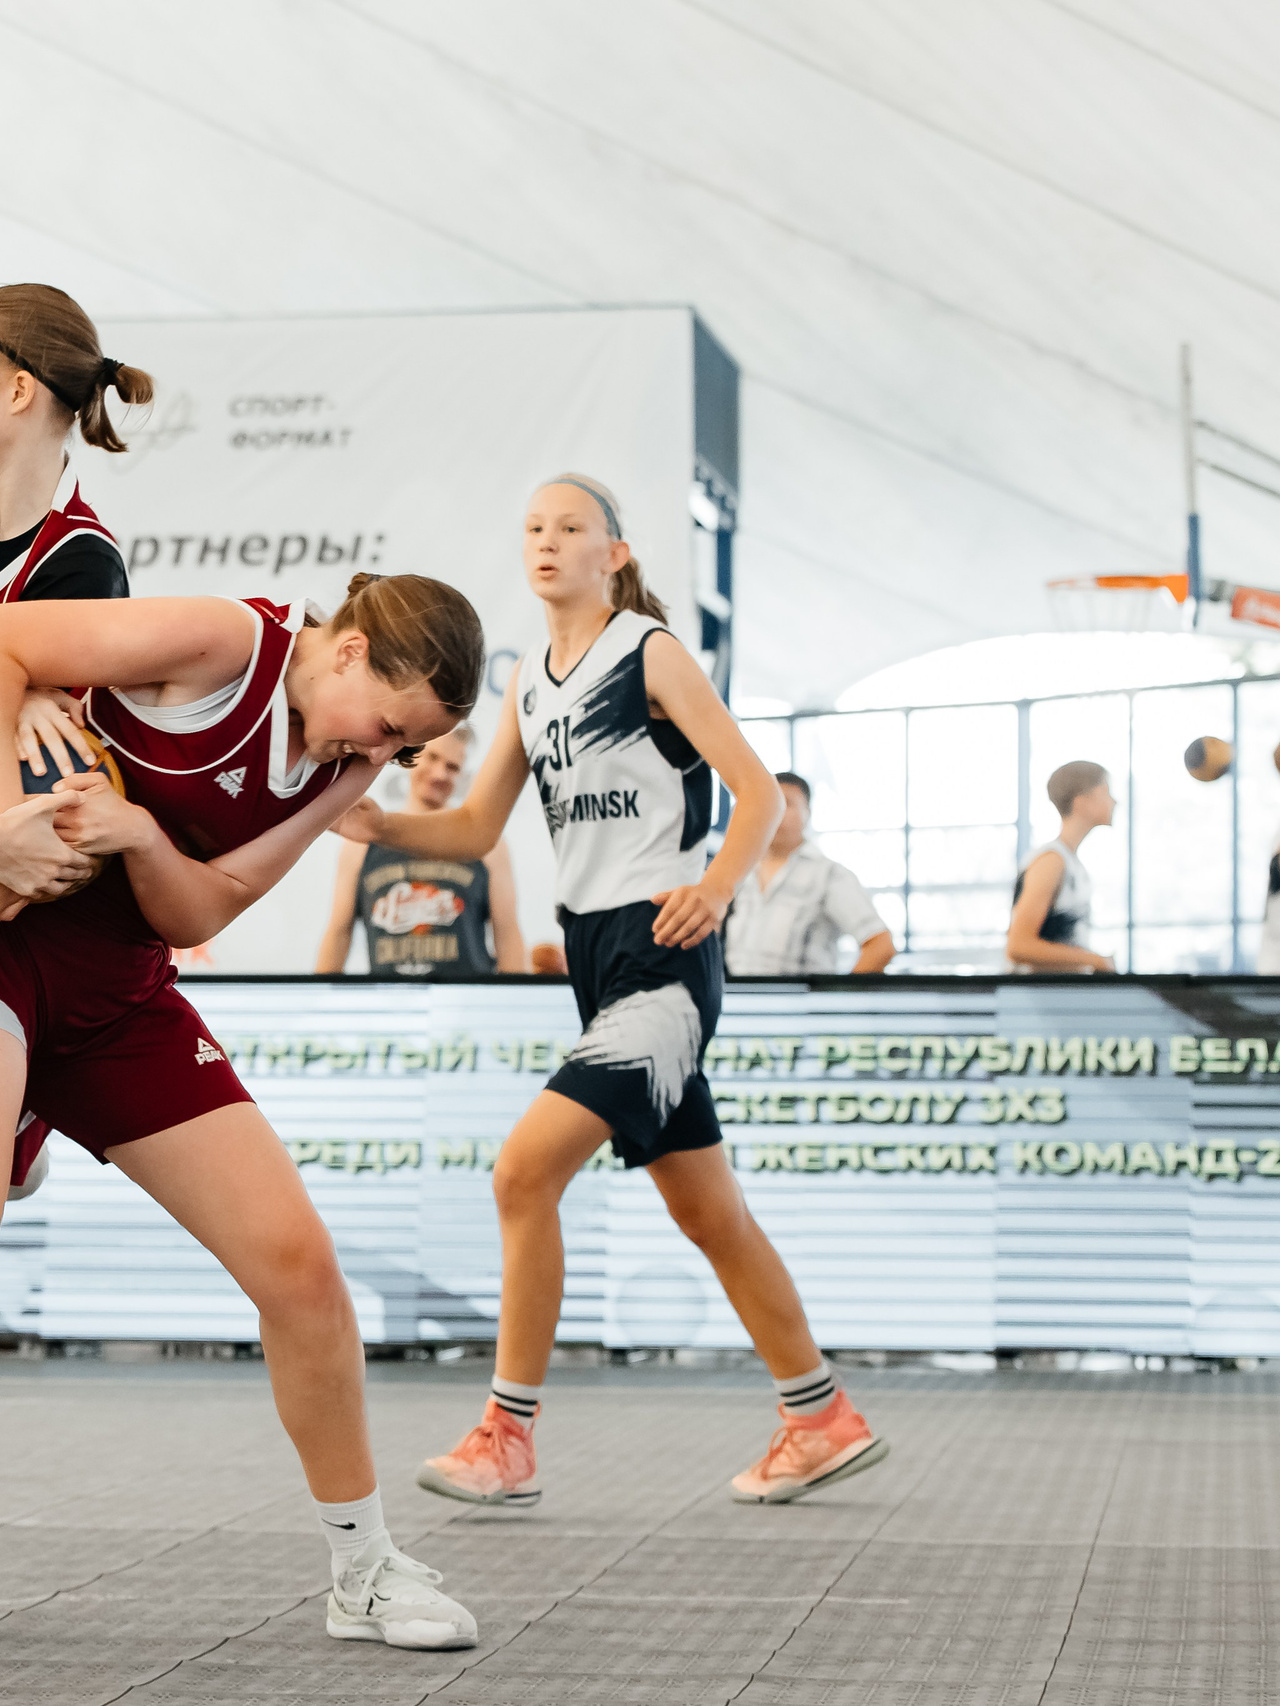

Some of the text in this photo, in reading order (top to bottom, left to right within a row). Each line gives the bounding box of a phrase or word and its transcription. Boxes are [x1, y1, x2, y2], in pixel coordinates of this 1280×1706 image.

[229, 427, 352, 450] ФОРМАТ
[118, 532, 386, 577] ртнеры:
[546, 714, 572, 772] 31
[820, 1035, 1154, 1073] РЕСПУБЛИКИ
[1170, 1034, 1280, 1073] БЕЛ
[715, 1091, 965, 1124] СКЕТБОЛУ
[283, 1139, 422, 1173] РЕДИ
[752, 1139, 994, 1173] ЖЕНСКИХ
[1013, 1138, 1280, 1181] КОМАНД-2
